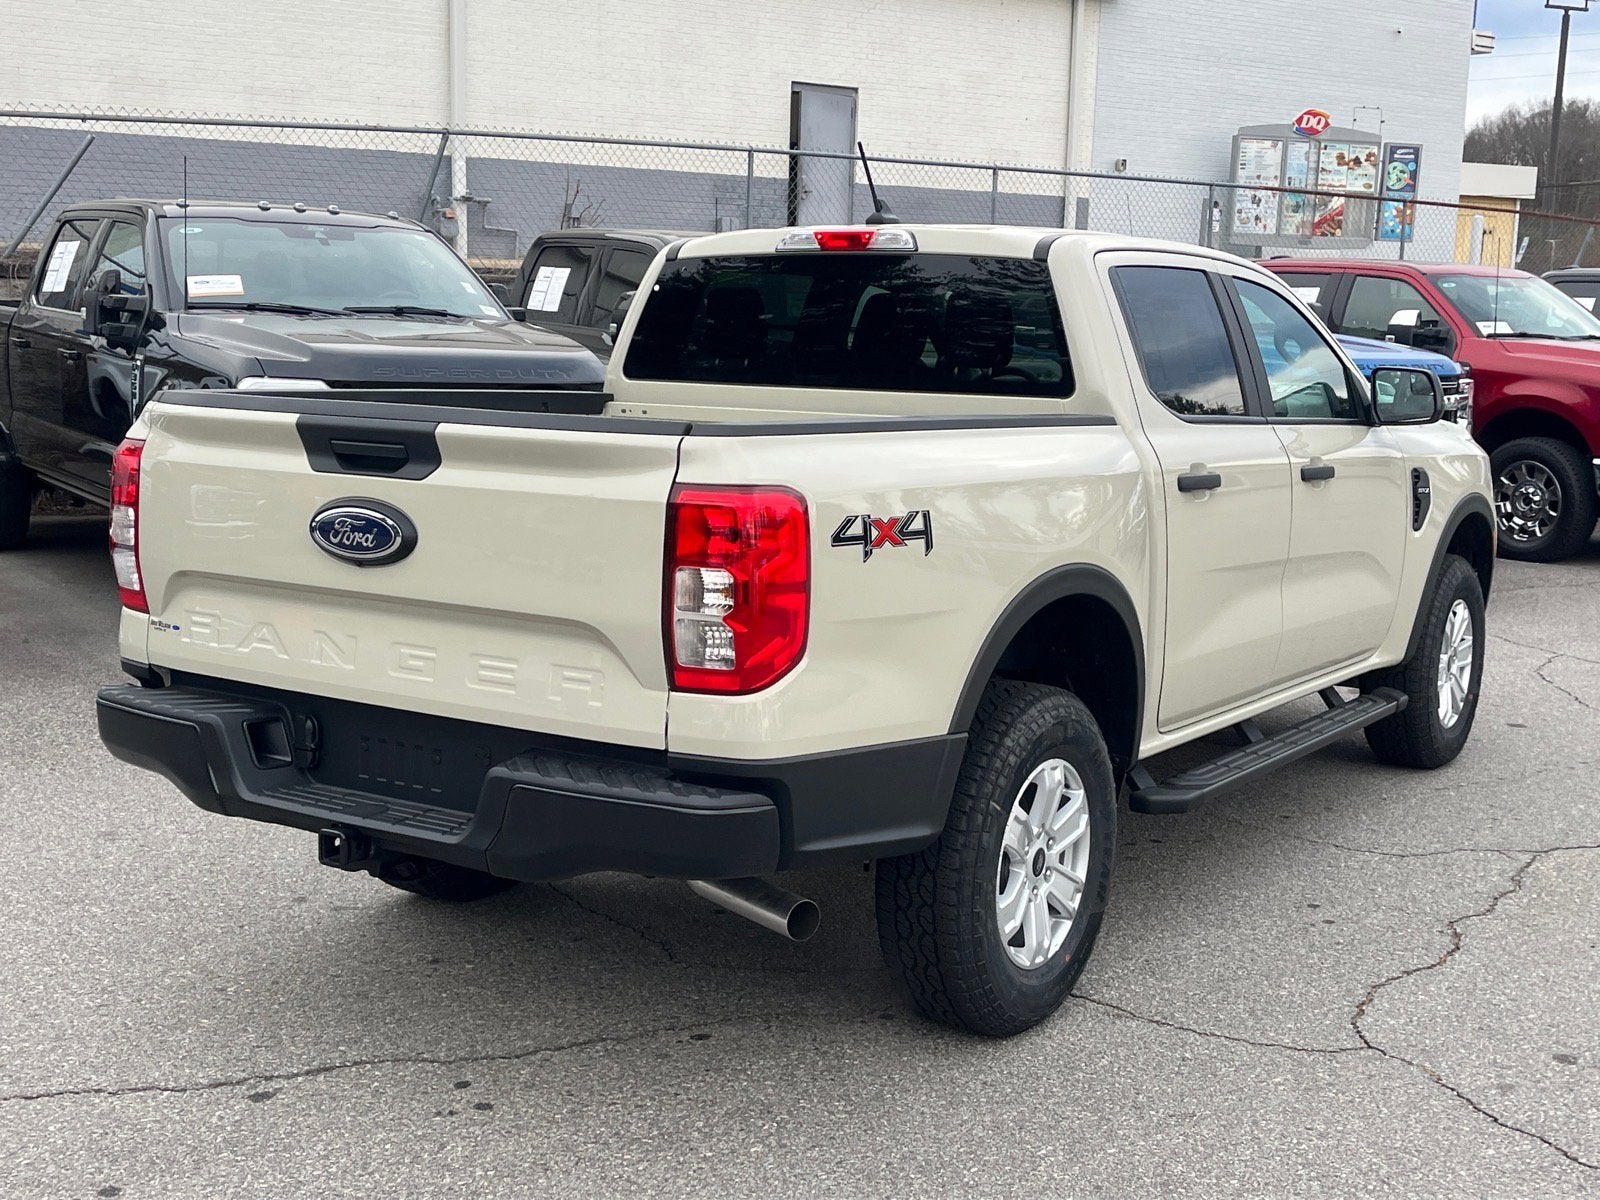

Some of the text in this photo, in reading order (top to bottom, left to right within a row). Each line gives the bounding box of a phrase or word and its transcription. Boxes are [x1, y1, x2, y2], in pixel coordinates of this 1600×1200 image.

[1300, 114, 1326, 131] DQ
[372, 367, 573, 380] SUPER DUTY
[329, 517, 378, 548] Ford
[181, 607, 606, 707] RANGER
